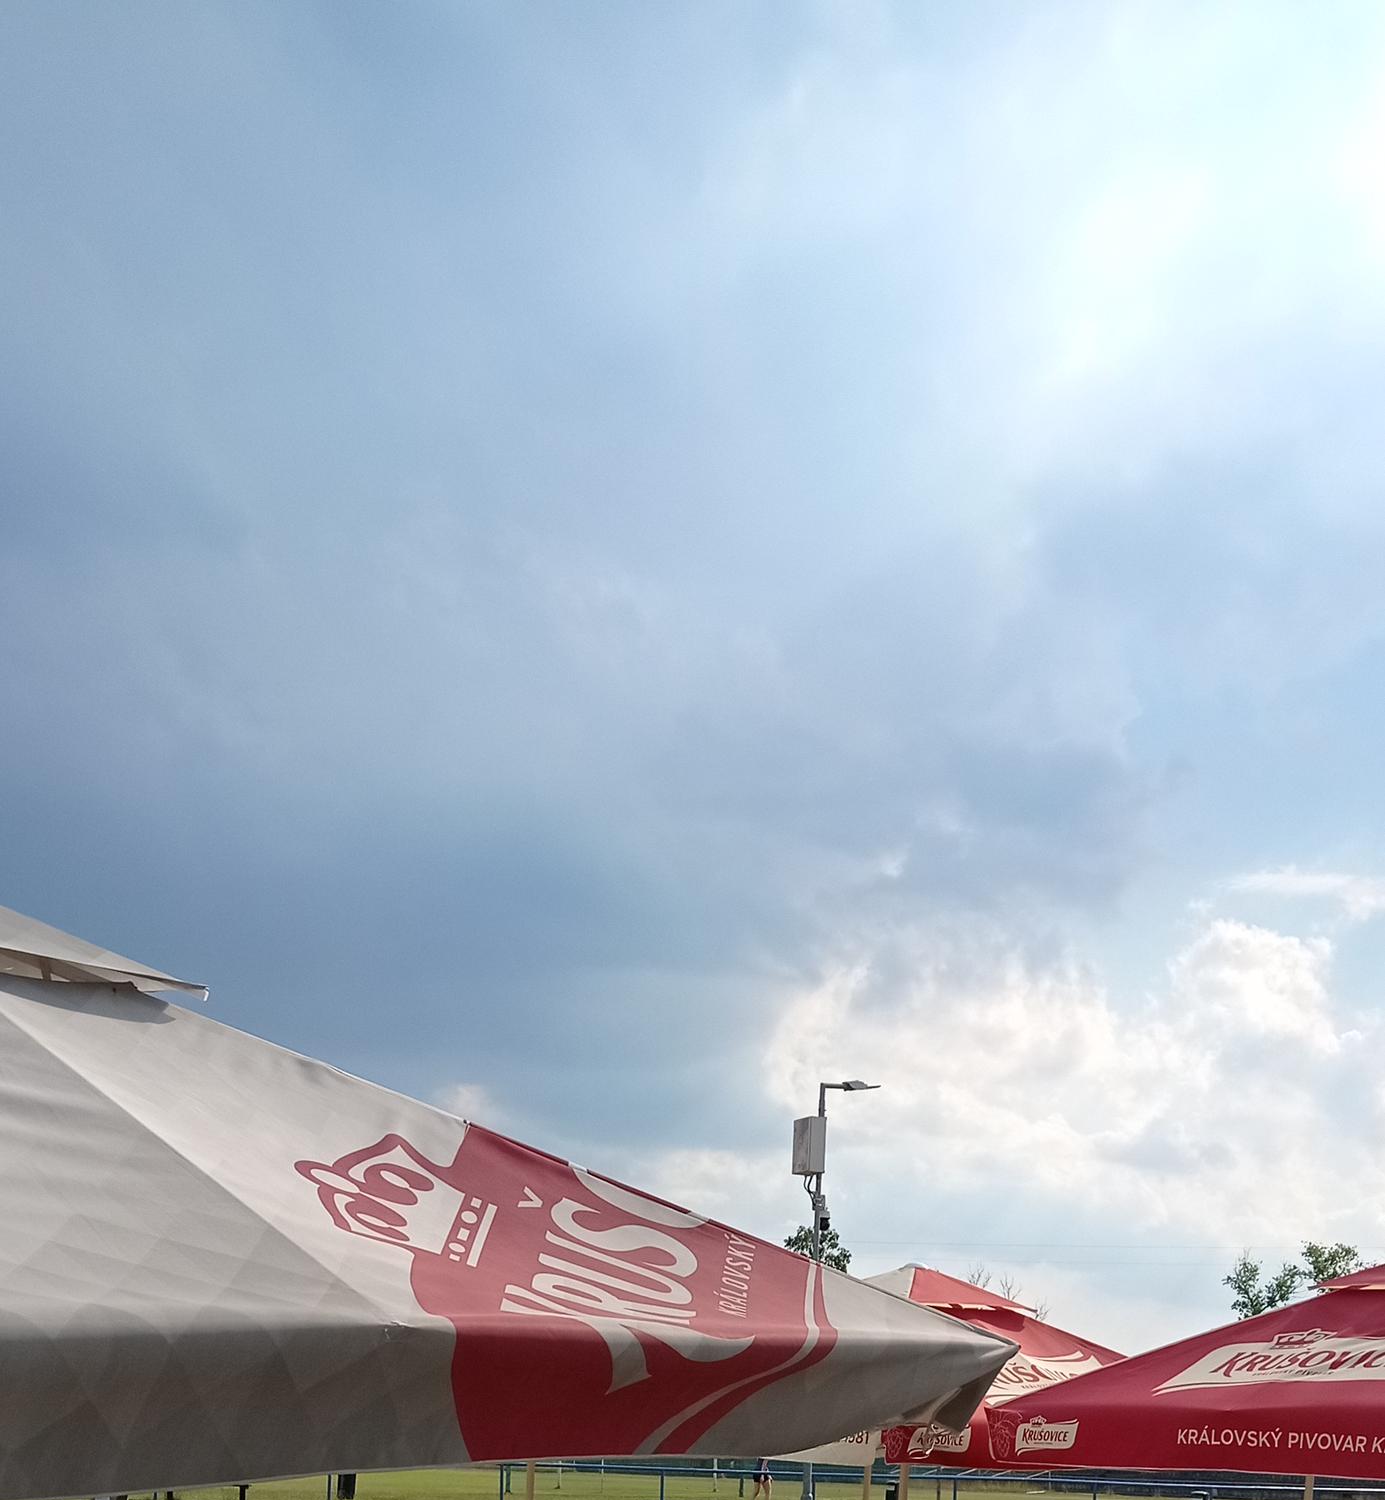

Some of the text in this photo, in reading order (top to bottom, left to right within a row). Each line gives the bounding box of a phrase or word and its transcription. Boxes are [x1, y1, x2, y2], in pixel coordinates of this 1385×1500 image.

[713, 1232, 756, 1319] KRÁLOVSKÝ
[1209, 1348, 1385, 1378] KRUŠOVIC
[1022, 1427, 1070, 1445] KRUŠOVICE
[1176, 1425, 1281, 1448] KRÁLOVSKÝ
[1287, 1431, 1366, 1453] PIVOVAR
